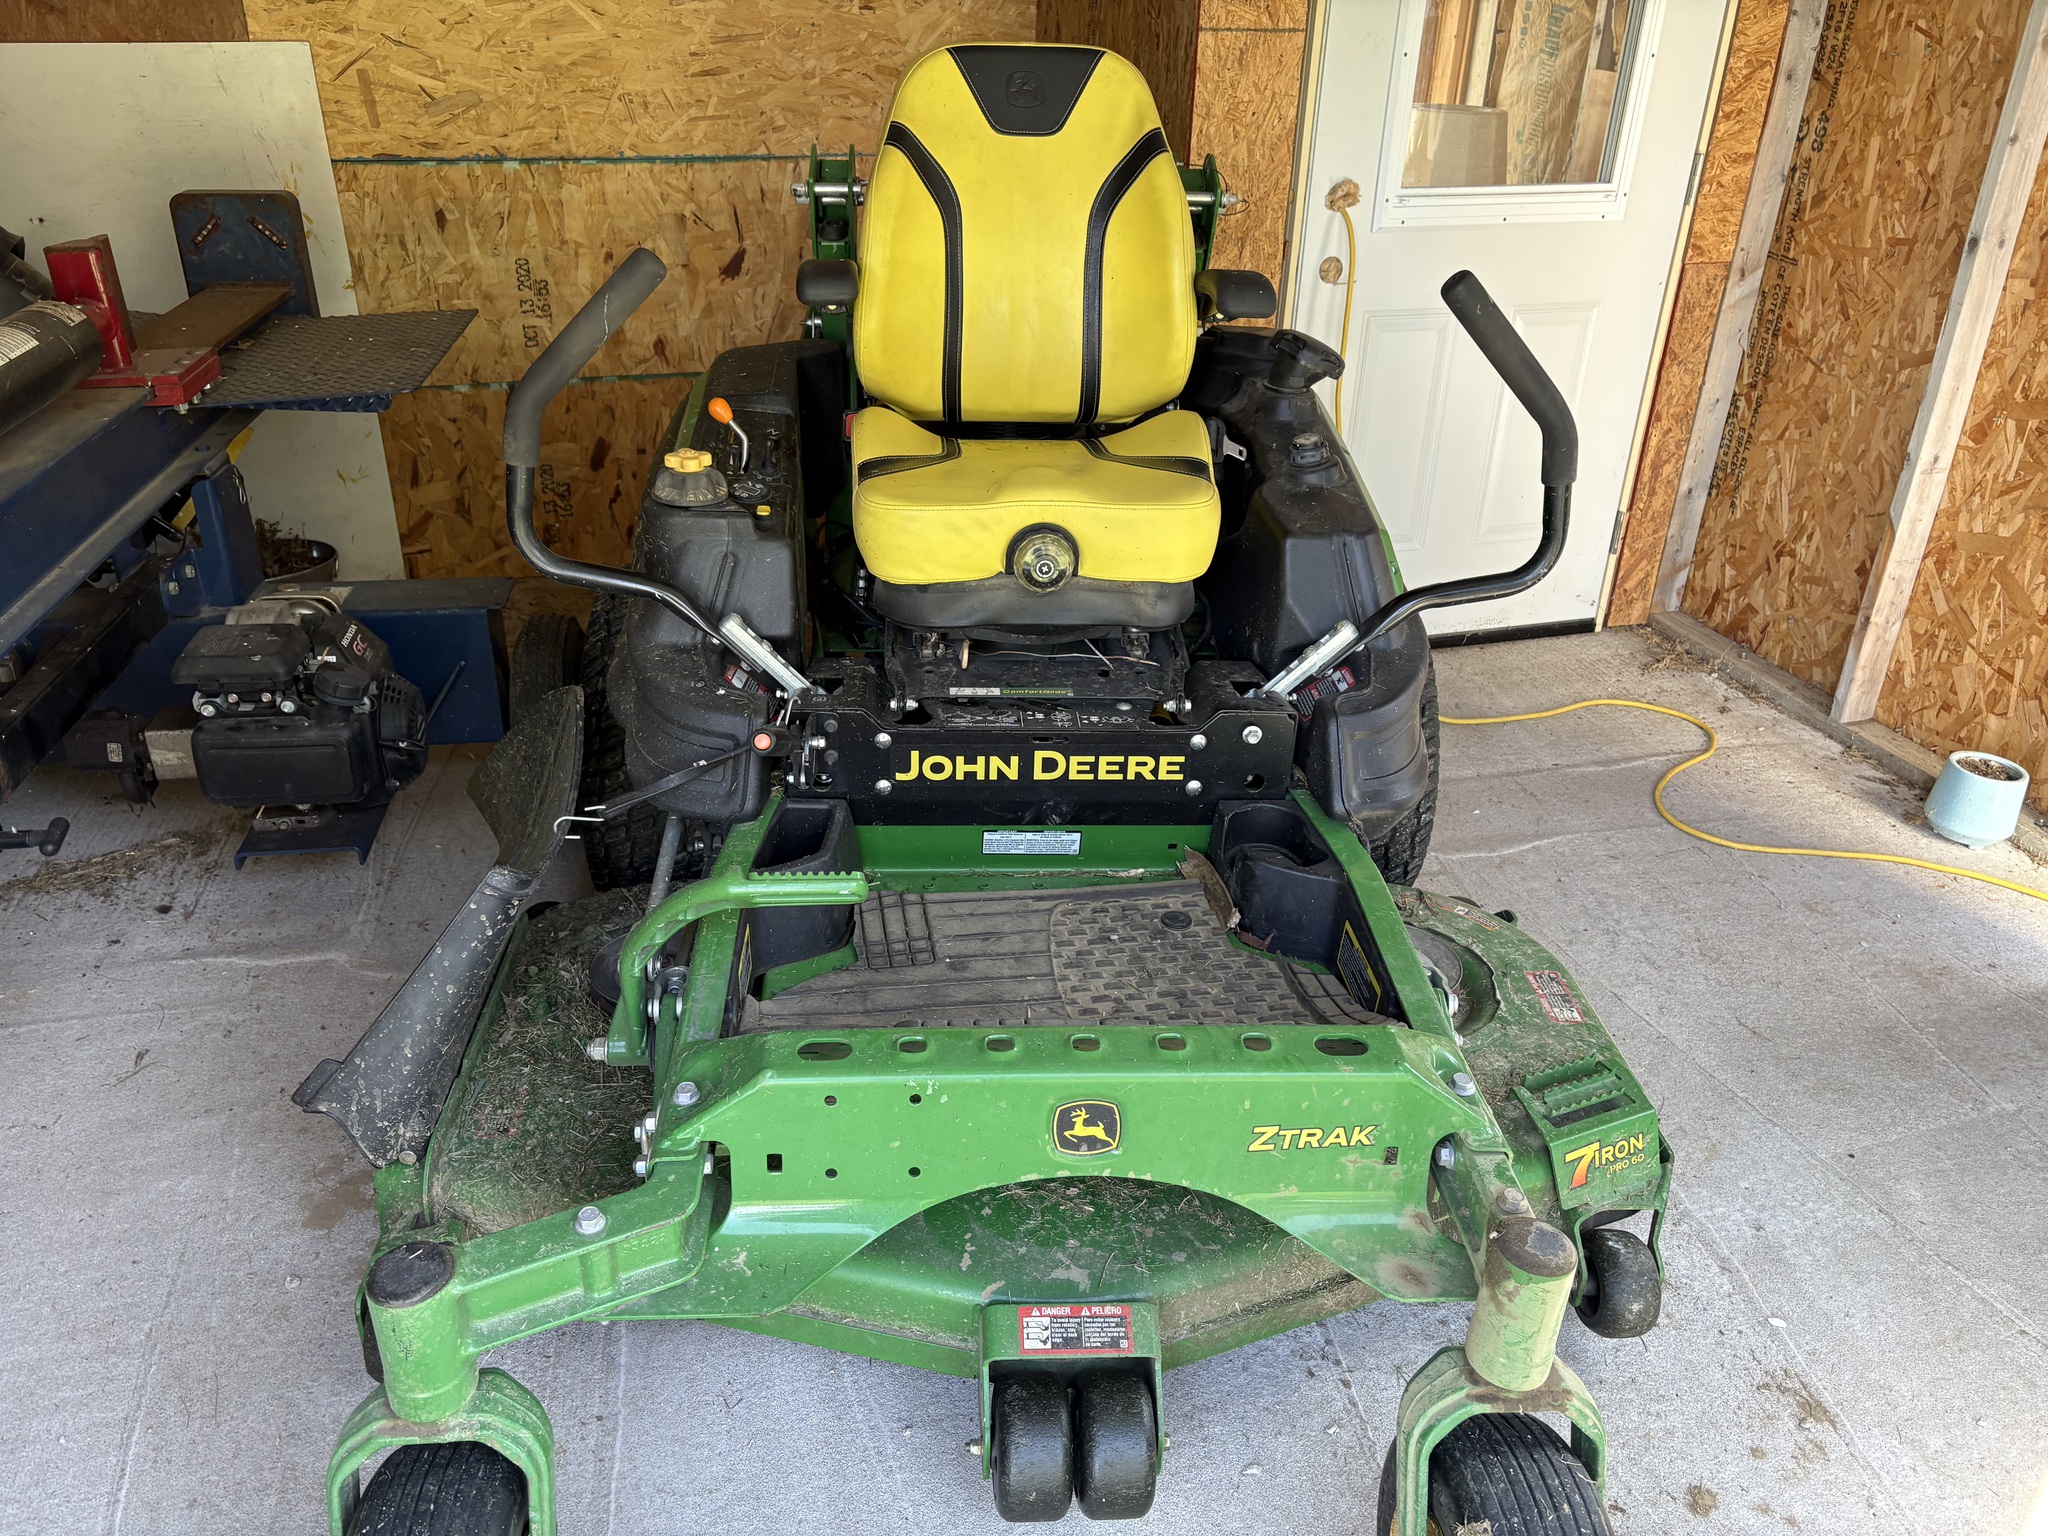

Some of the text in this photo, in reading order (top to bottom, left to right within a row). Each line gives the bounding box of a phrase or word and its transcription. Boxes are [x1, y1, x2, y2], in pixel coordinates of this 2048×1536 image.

[1539, 3, 1574, 59] KNAUF
[1824, 4, 1836, 33] CSA
[1833, 1, 1848, 33] 2F16
[1828, 33, 1851, 109] SHEATHING
[1811, 110, 1830, 153] 498
[1782, 156, 1812, 254] STRENGTH AXIS
[514, 258, 539, 349] OCT 13 2020
[1778, 285, 1792, 312] THIS
[1750, 265, 1786, 391] CE COTE EN DESSOUS
[1771, 313, 1783, 341] SIDE
[1746, 326, 1759, 360] CLIPS
[1732, 397, 1743, 420] LES
[1748, 393, 1763, 431] SPACE
[1721, 421, 1736, 459] COTES
[1728, 426, 1746, 477] ESPACER
[1742, 432, 1753, 455] ALL
[539, 464, 556, 495] 2020
[1718, 459, 1727, 474] DE
[543, 500, 558, 516] 13
[340, 624, 358, 648] HONDA
[352, 633, 368, 657] GC
[895, 750, 1185, 782] JOHN DEERE
[1247, 1124, 1379, 1153] ZTRAK
[1609, 1153, 1645, 1174] PRO 60
[1041, 1307, 1071, 1315] DANGER
[1091, 1306, 1122, 1315] PELIGRO
